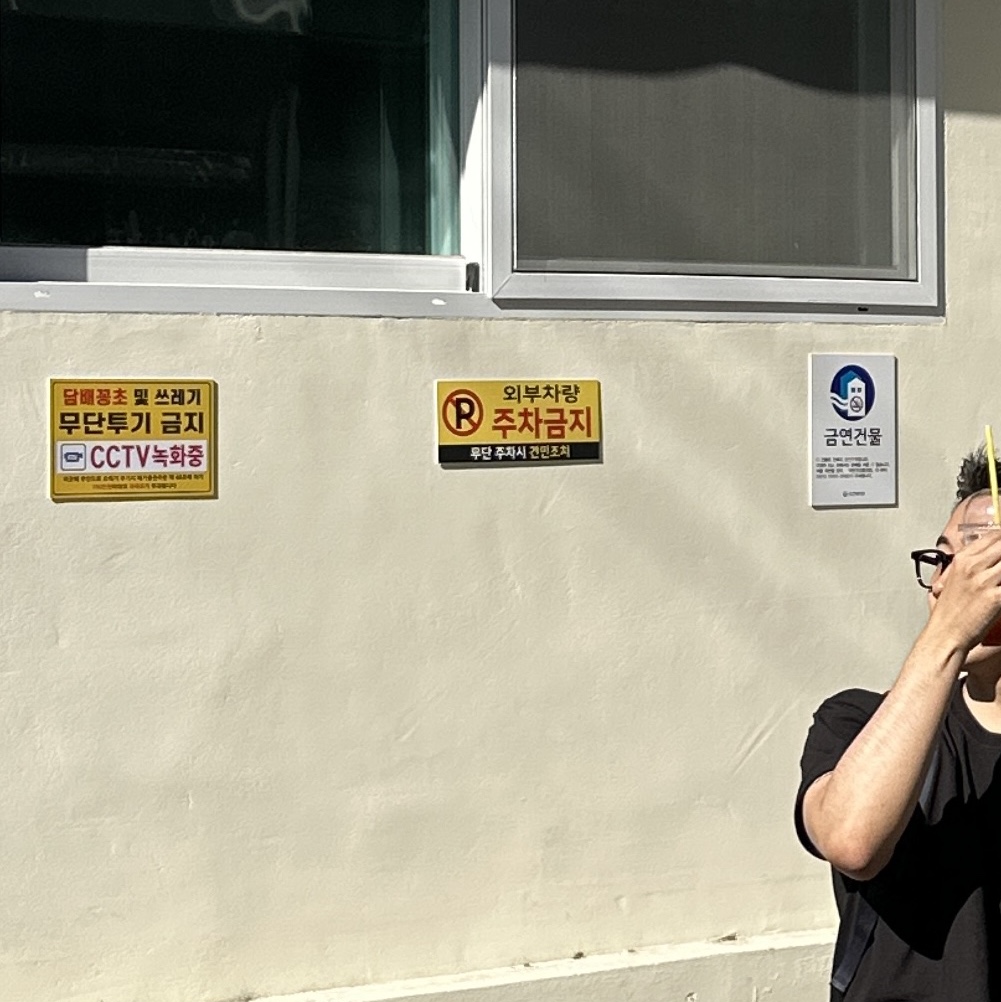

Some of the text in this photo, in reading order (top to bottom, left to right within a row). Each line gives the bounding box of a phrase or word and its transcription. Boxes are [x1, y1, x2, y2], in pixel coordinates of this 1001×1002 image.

[63, 388, 201, 406] 담배꽁초 및 쓰레기
[503, 383, 581, 404] 외부차량
[59, 411, 204, 435] 무단투기 금지
[491, 406, 592, 440] 주차금지
[824, 427, 883, 447] 금연건물
